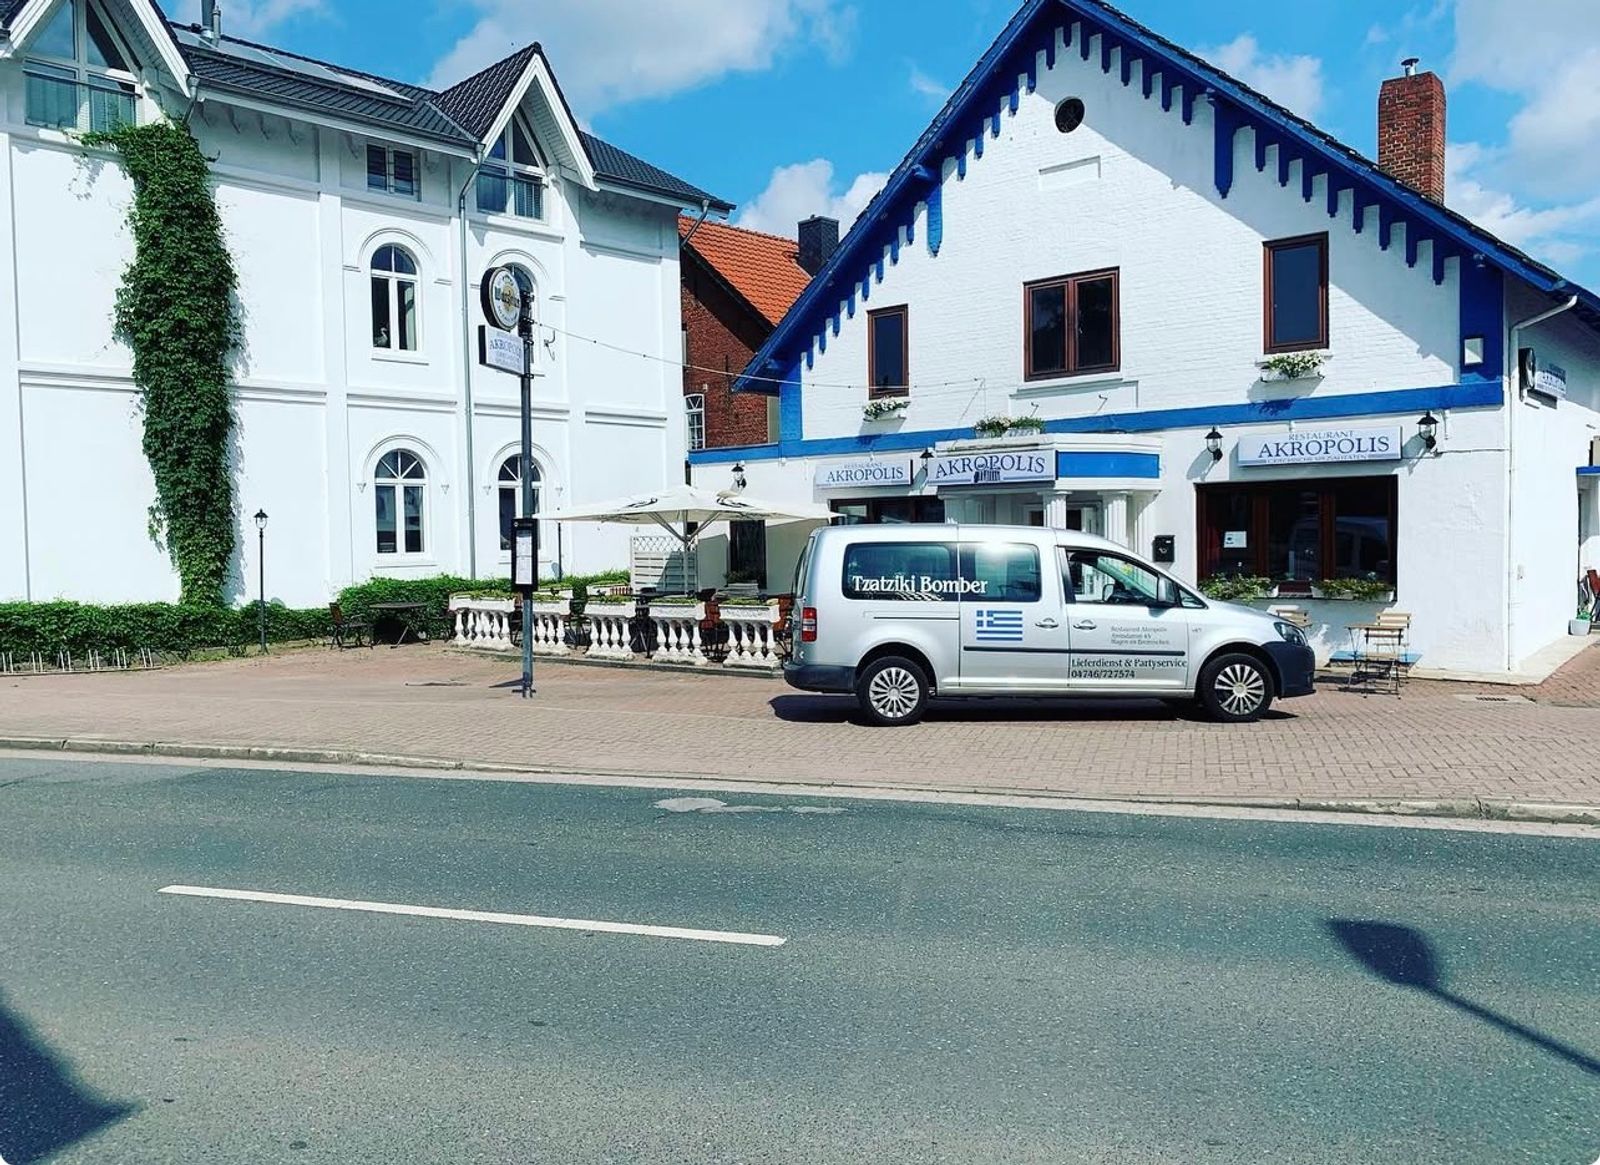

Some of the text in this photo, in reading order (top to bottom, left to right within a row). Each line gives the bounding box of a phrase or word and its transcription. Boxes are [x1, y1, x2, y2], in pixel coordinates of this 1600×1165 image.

[1288, 430, 1354, 441] RESTAURANT
[1258, 435, 1390, 459] AKROPOLIS
[935, 454, 1046, 479] AKROPOLIS
[826, 467, 904, 482] AKROPOLIS
[852, 575, 988, 593] Tzatziki Bomber
[1071, 658, 1188, 670] Lieferdienst & Partyservice
[1071, 670, 1135, 679] 04746/727574
